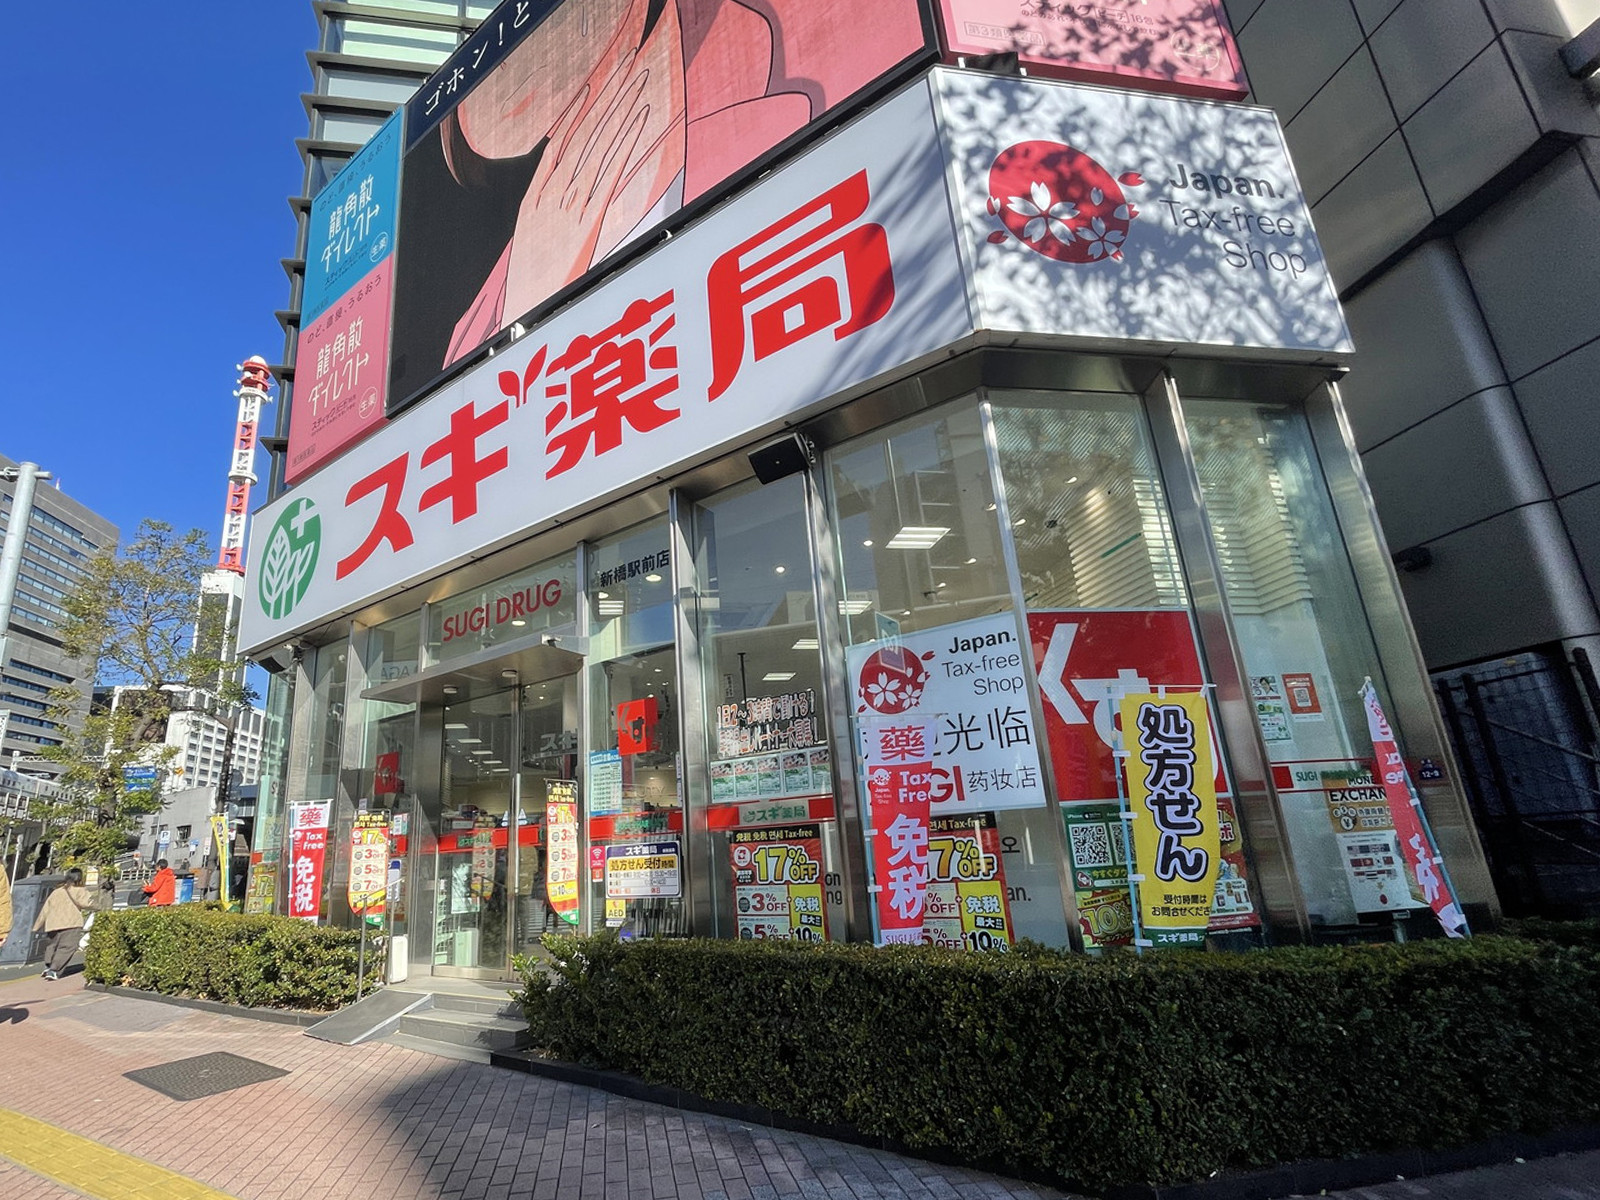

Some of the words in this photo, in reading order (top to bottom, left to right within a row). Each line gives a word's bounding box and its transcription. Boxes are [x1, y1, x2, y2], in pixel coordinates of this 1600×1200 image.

[1169, 163, 1285, 199] Japan.
[328, 174, 374, 240] 龍角散
[1160, 200, 1296, 237] Tax-free
[321, 204, 380, 273] ダイレクト
[1223, 241, 1307, 280] Shop
[316, 315, 364, 380] 龍角散
[308, 352, 370, 416] ダイレクト
[336, 168, 896, 581] スギ薬局
[600, 550, 670, 588] 新橋駅前店
[443, 607, 490, 642] SUGI
[496, 579, 562, 625] DRUG
[948, 629, 1017, 653] Japan.
[942, 653, 1020, 678] Tax-free
[974, 676, 1024, 695] Shop
[900, 770, 932, 786] Tax
[967, 766, 1037, 794] 药妆店
[1296, 771, 1318, 781] SUGI
[1348, 775, 1376, 785] MONE
[1137, 703, 1207, 881] 処方せん
[1329, 789, 1388, 801] EXCHAN
[756, 806, 806, 820] スギ薬局
[948, 817, 987, 830] Tax-fre
[306, 832, 323, 840] Tax
[785, 828, 813, 839] Tax-free
[884, 813, 928, 919] 免税
[929, 838, 978, 878] 7%
[958, 856, 994, 878] OFF
[295, 856, 316, 912] 免税
[789, 863, 818, 881] OFF
[752, 893, 777, 912] 3%
[766, 902, 787, 911] OFF
[794, 896, 820, 912] 免税
[931, 903, 956, 913] OFF
[966, 896, 1001, 914] 免税
[1164, 894, 1207, 904] 受付時間は
[608, 909, 624, 917] AED
